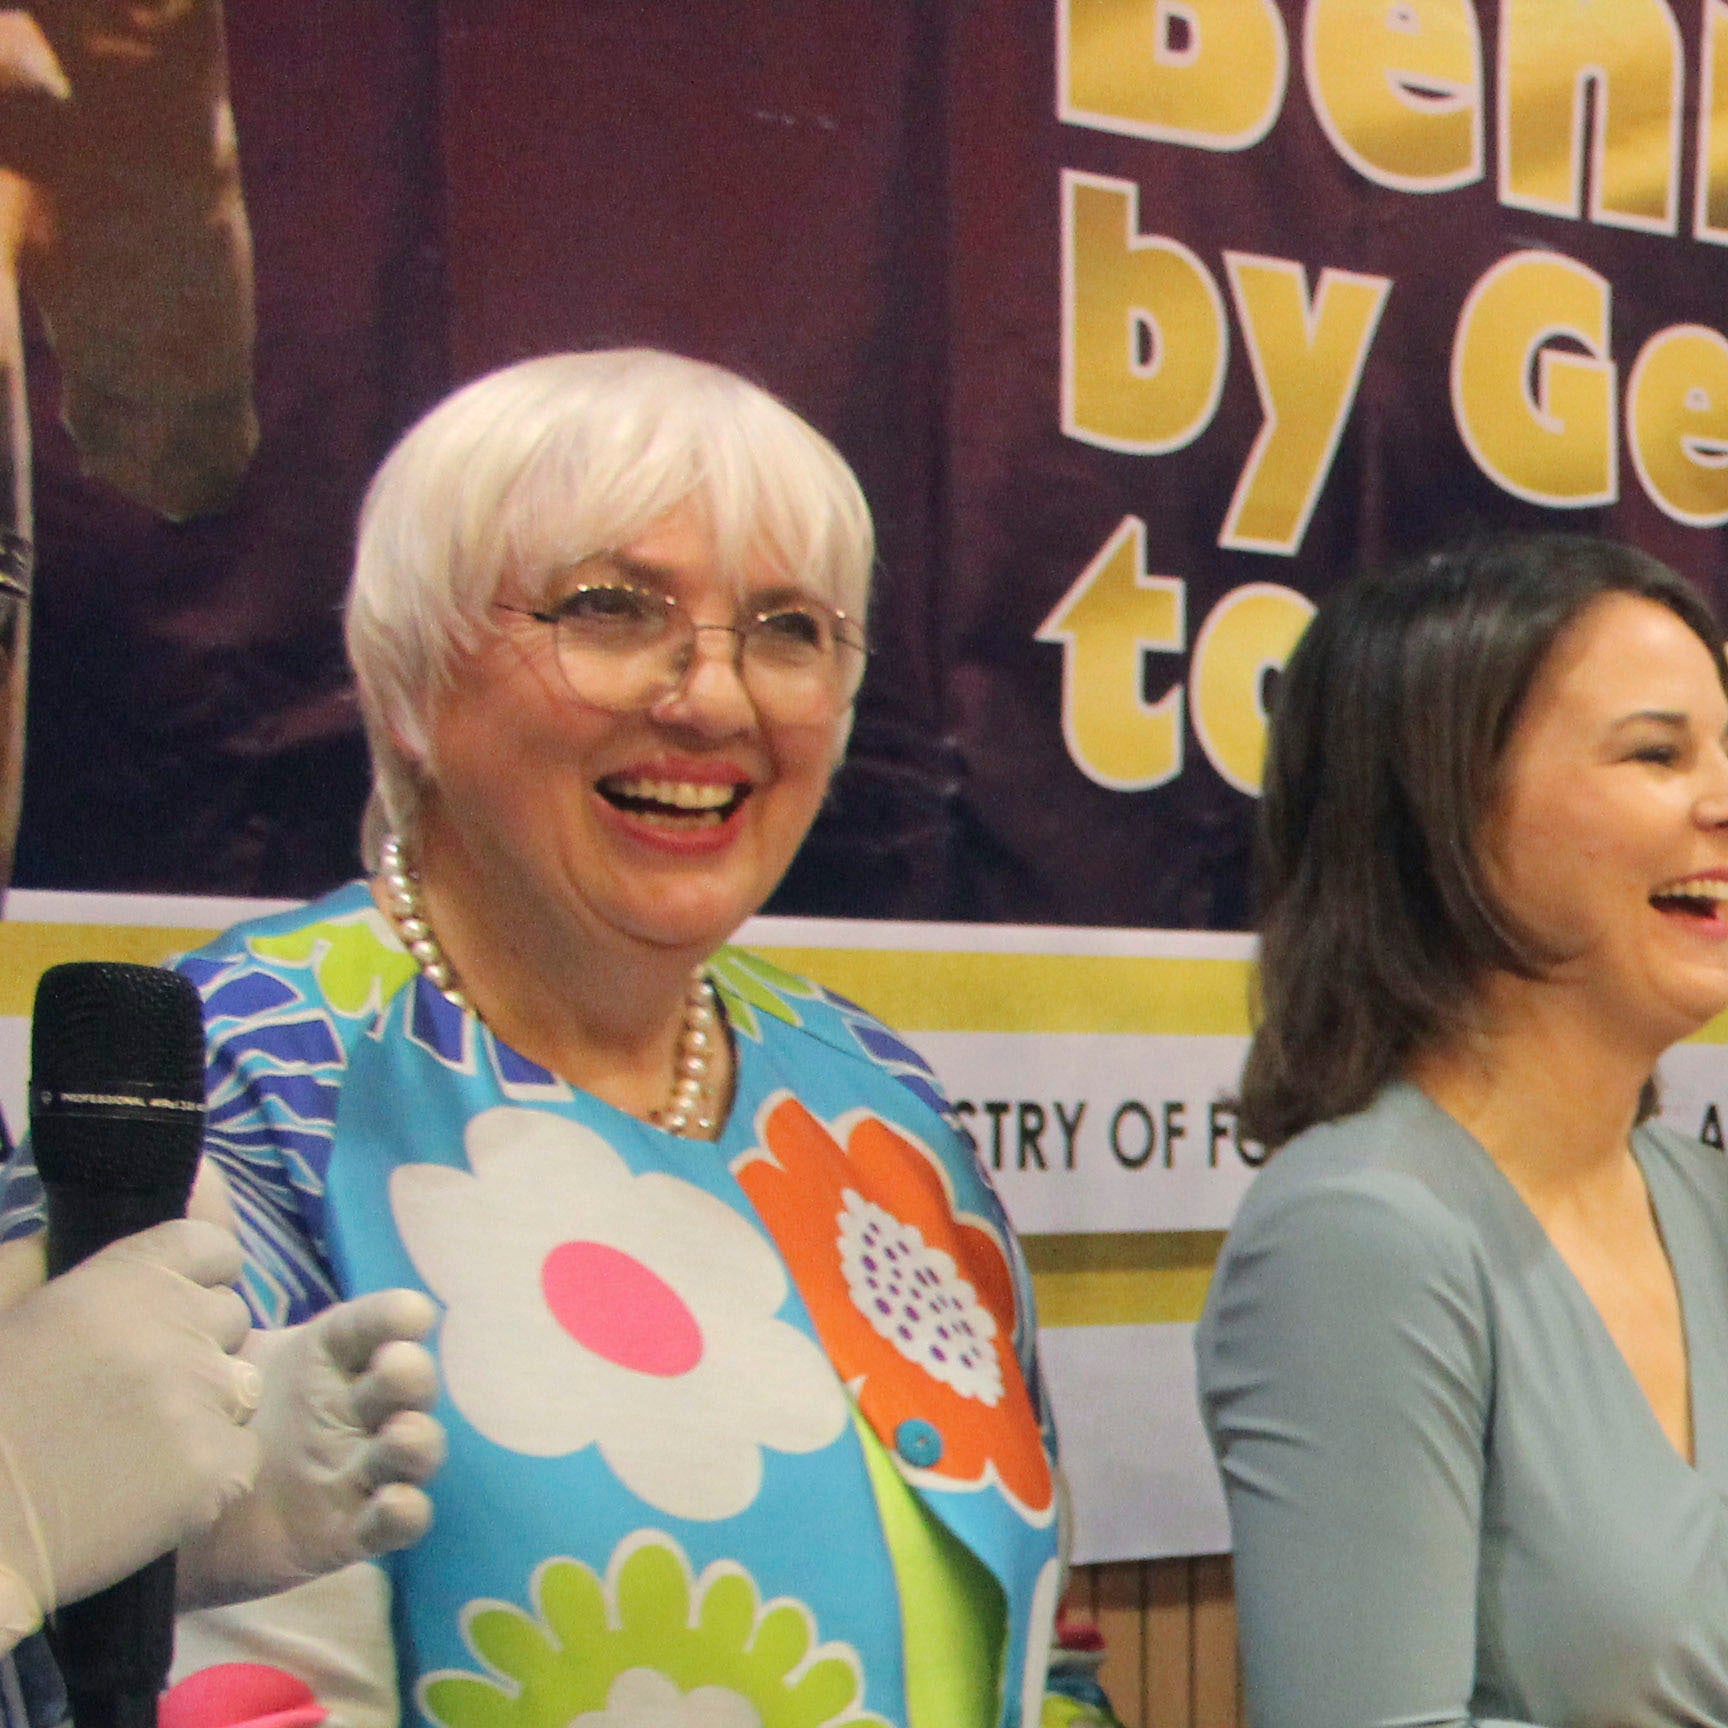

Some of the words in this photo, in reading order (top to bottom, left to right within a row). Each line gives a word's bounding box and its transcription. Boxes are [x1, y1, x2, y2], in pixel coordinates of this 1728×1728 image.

[1059, 167, 1394, 557] by
[1033, 514, 1319, 799] to
[1109, 1100, 1187, 1171] OF
